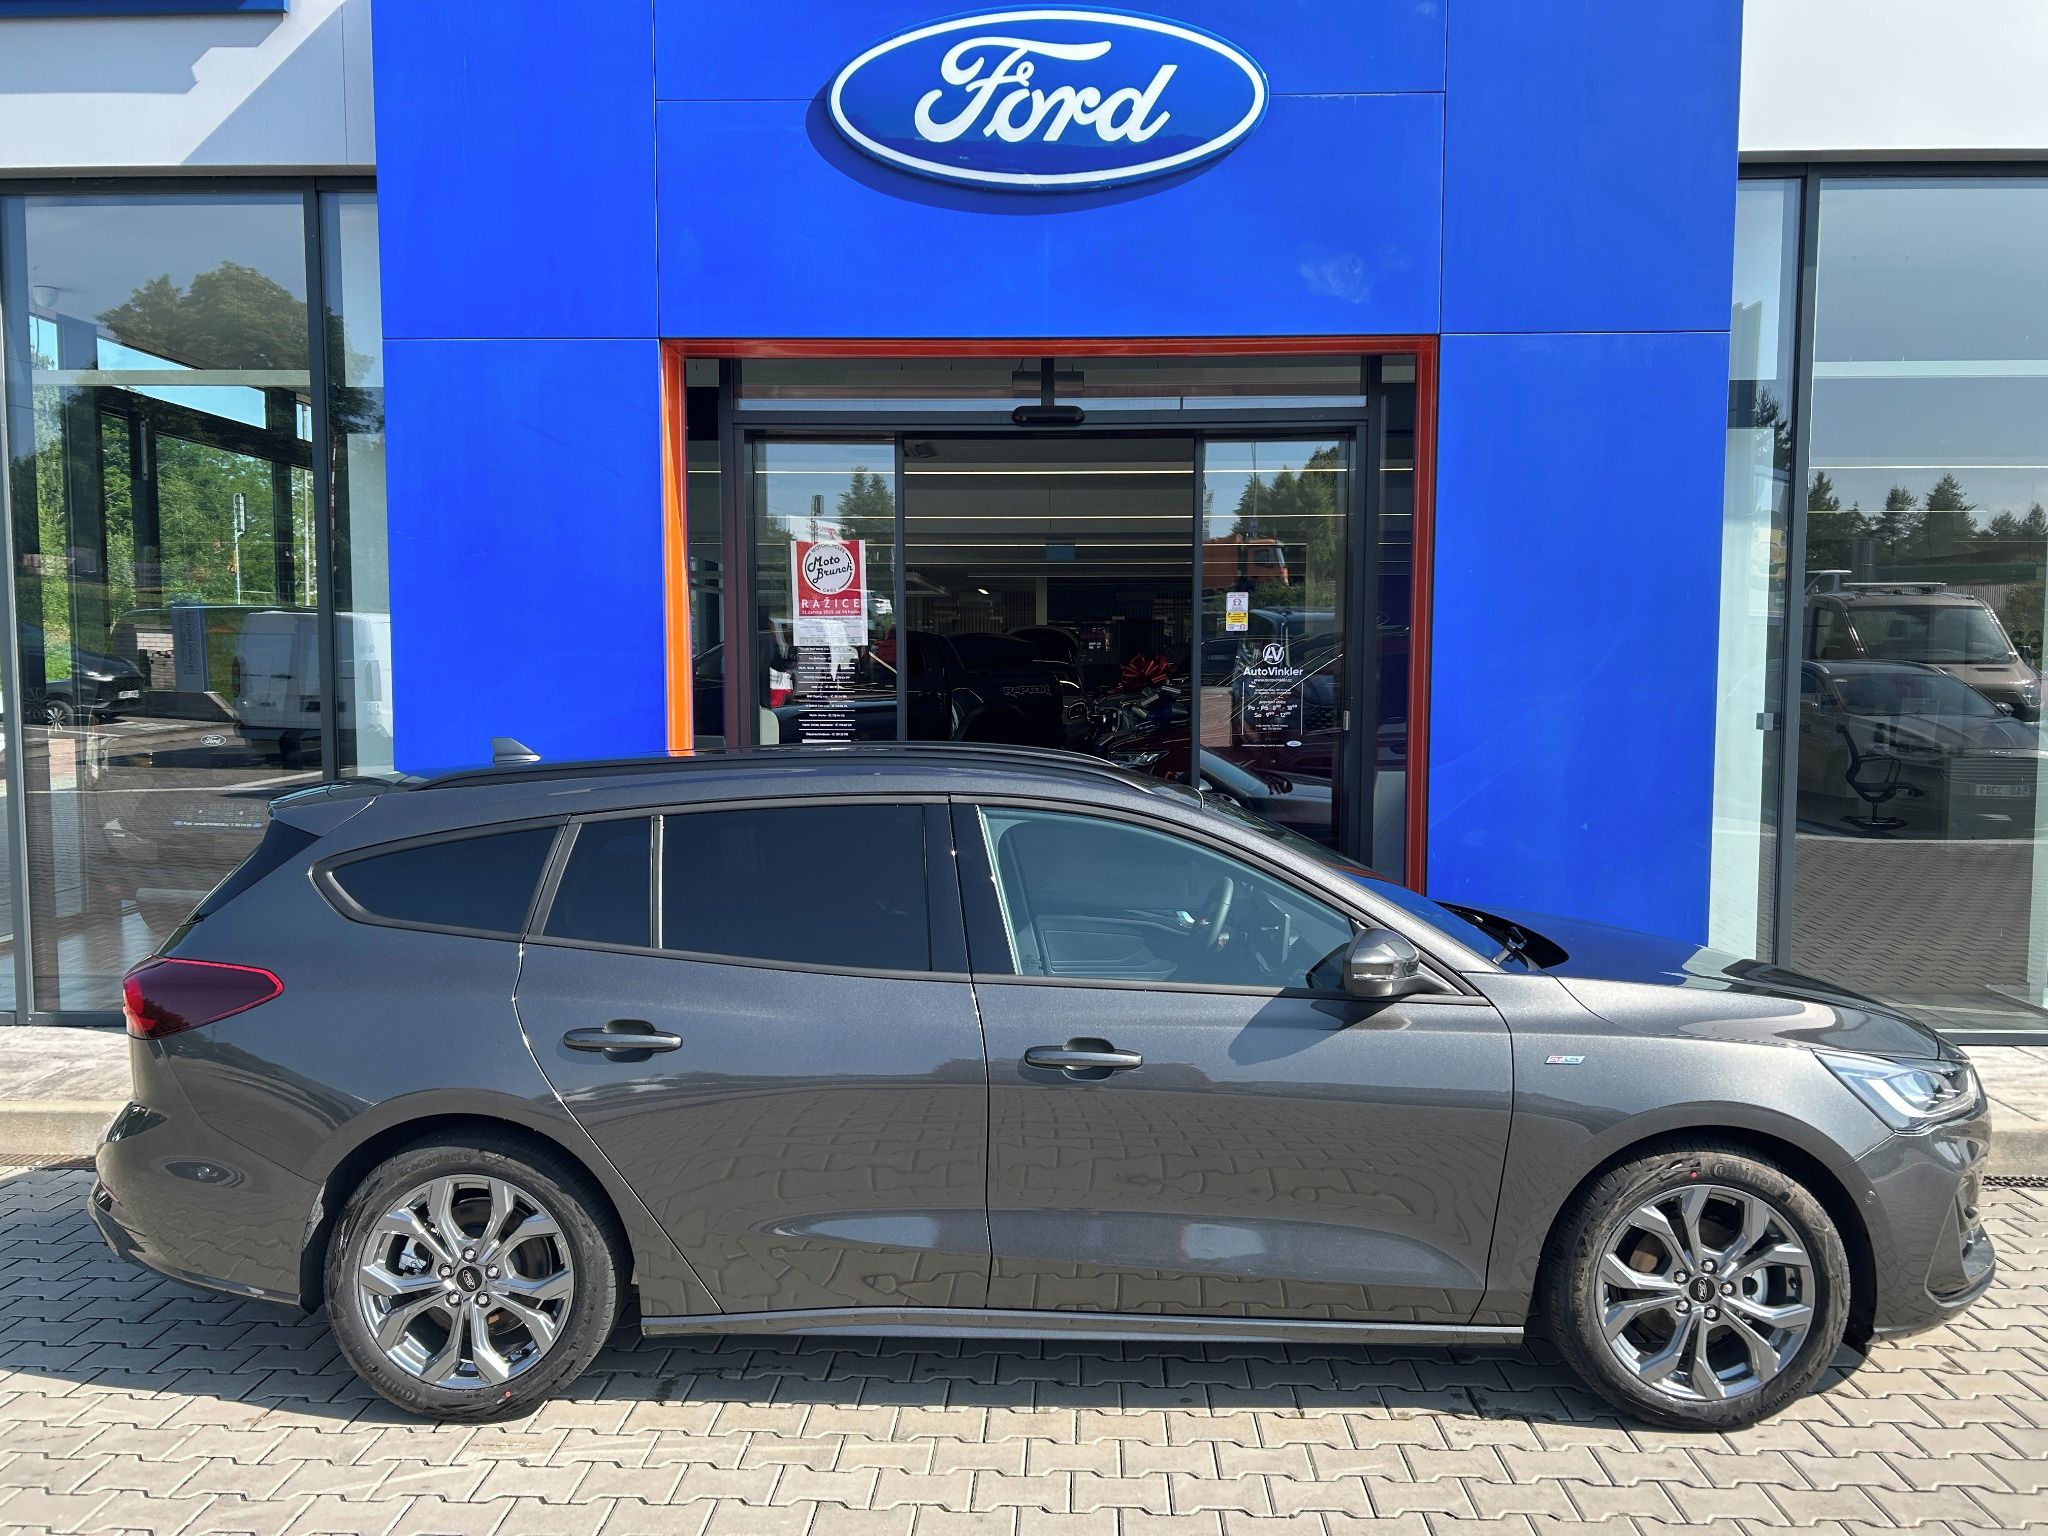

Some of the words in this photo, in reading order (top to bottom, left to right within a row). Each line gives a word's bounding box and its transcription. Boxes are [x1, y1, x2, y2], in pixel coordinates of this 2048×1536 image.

[914, 36, 1178, 143] Ford
[807, 555, 840, 572] Moto
[812, 562, 853, 584] Brunch
[801, 597, 860, 608] RAŽICE
[1263, 646, 1284, 662] AV
[1243, 667, 1304, 676] AutoVinkler
